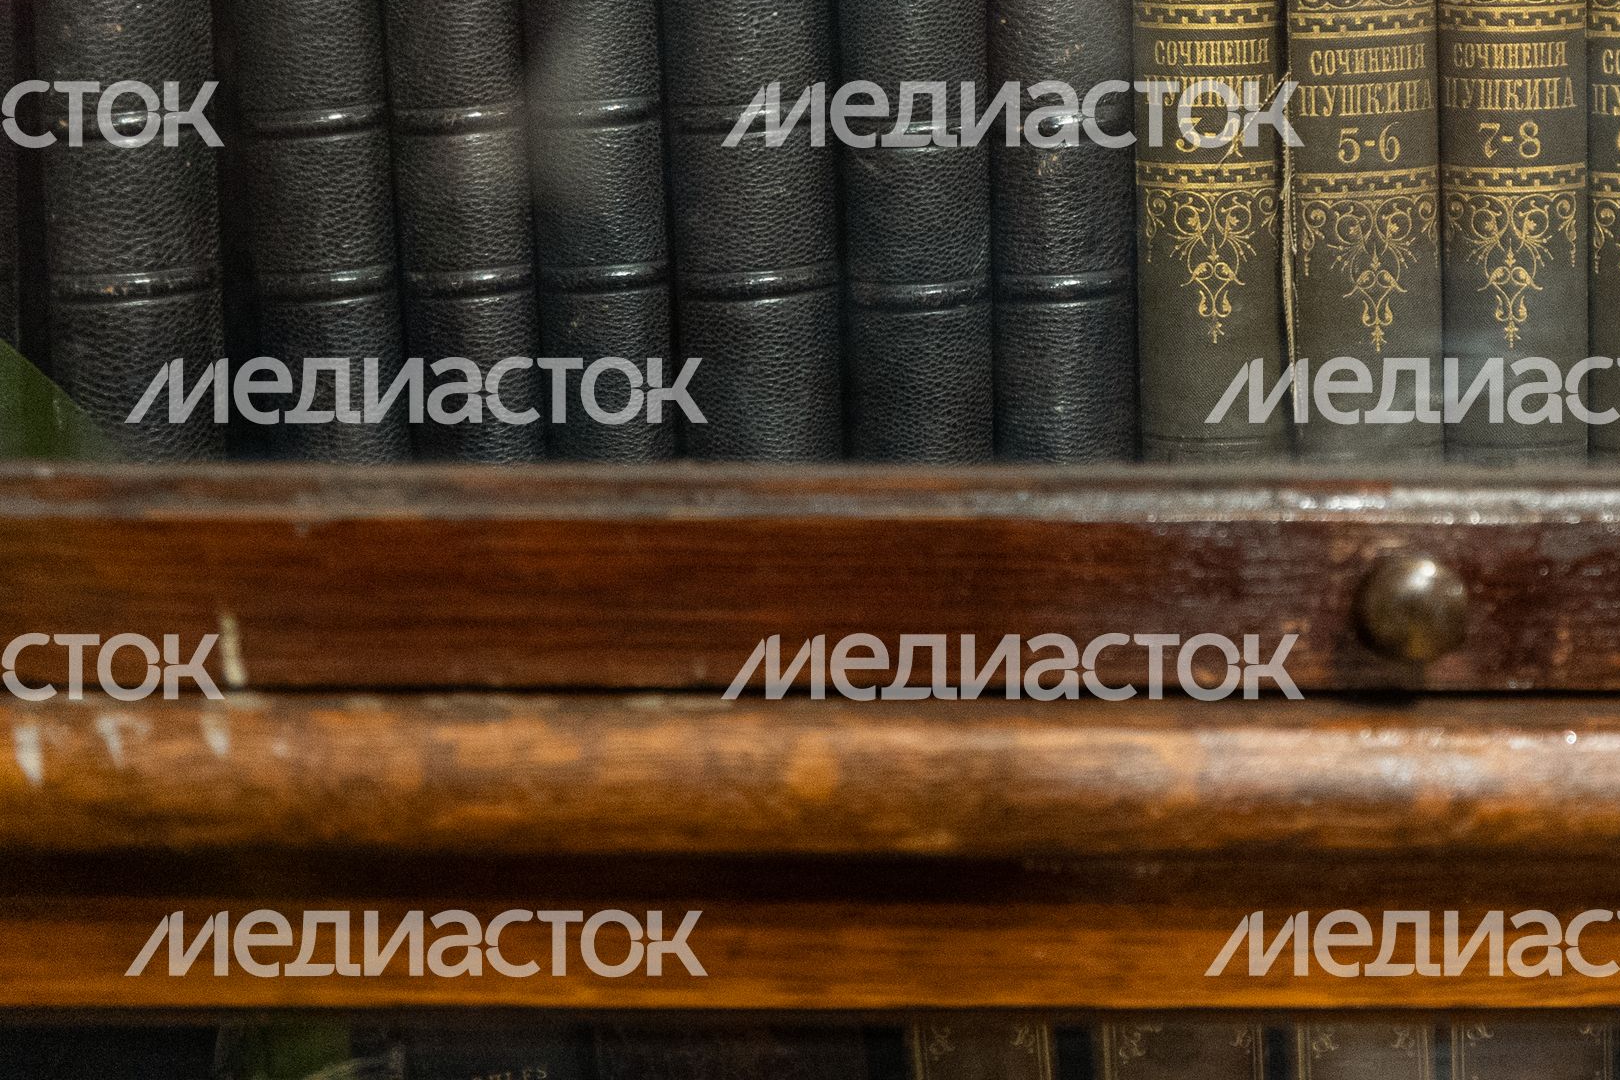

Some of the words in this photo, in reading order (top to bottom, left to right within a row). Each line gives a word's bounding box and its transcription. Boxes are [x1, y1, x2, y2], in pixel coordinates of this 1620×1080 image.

[1310, 43, 1425, 76] СОЧИНЕНІЯ
[1298, 79, 1435, 117] ПУШКИНА
[1444, 76, 1577, 110] ПУШКИНА
[1338, 121, 1400, 164] 5-6
[1479, 121, 1541, 158] 7-8
